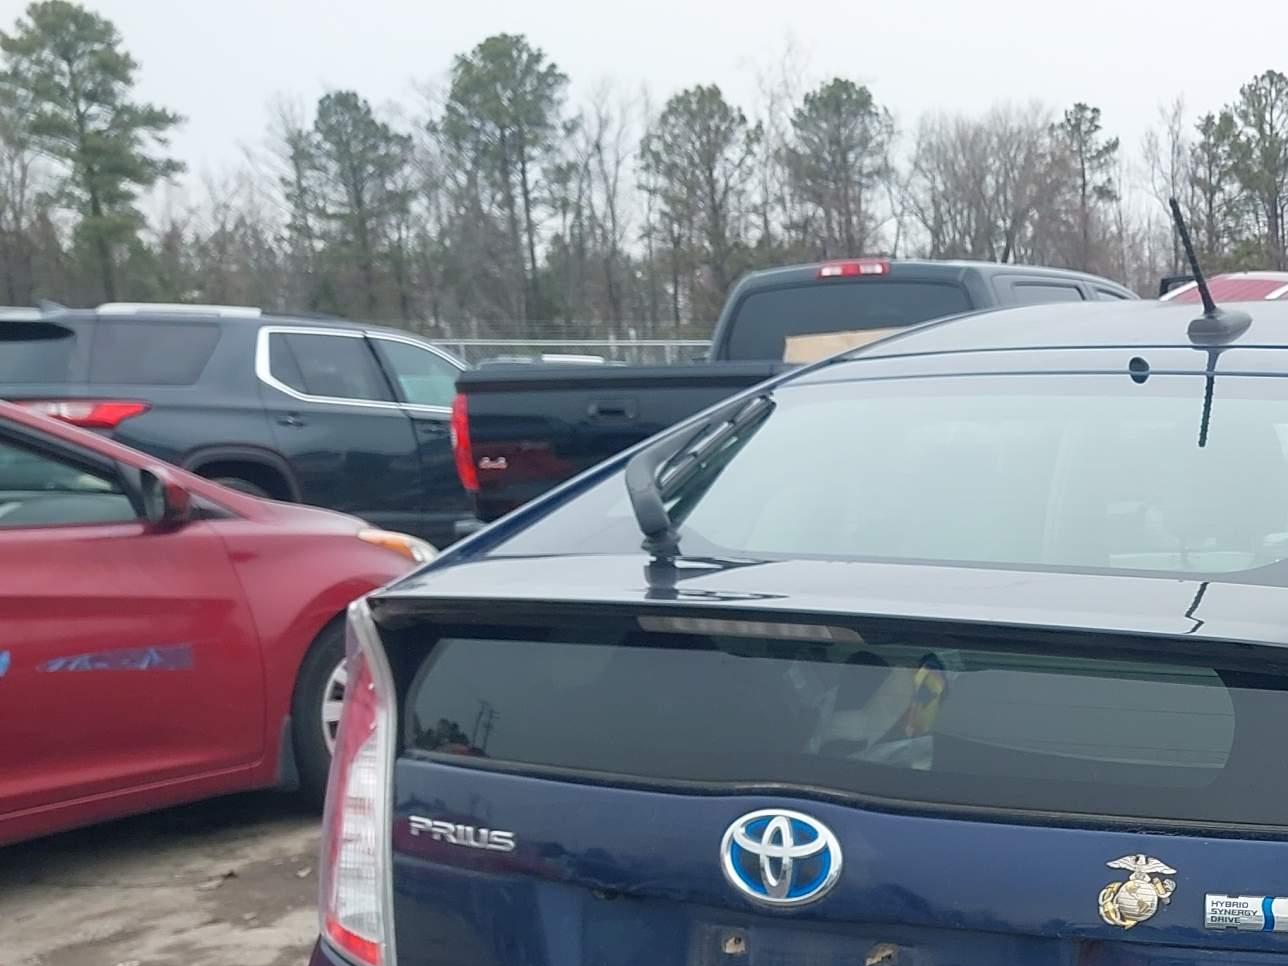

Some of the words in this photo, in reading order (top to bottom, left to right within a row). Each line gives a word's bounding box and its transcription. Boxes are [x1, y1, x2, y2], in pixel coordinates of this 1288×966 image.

[408, 815, 515, 852] PRIUS
[1211, 900, 1249, 909] HYBRID
[1210, 908, 1258, 917] SYNERGY
[1210, 915, 1241, 924] DRIVE
